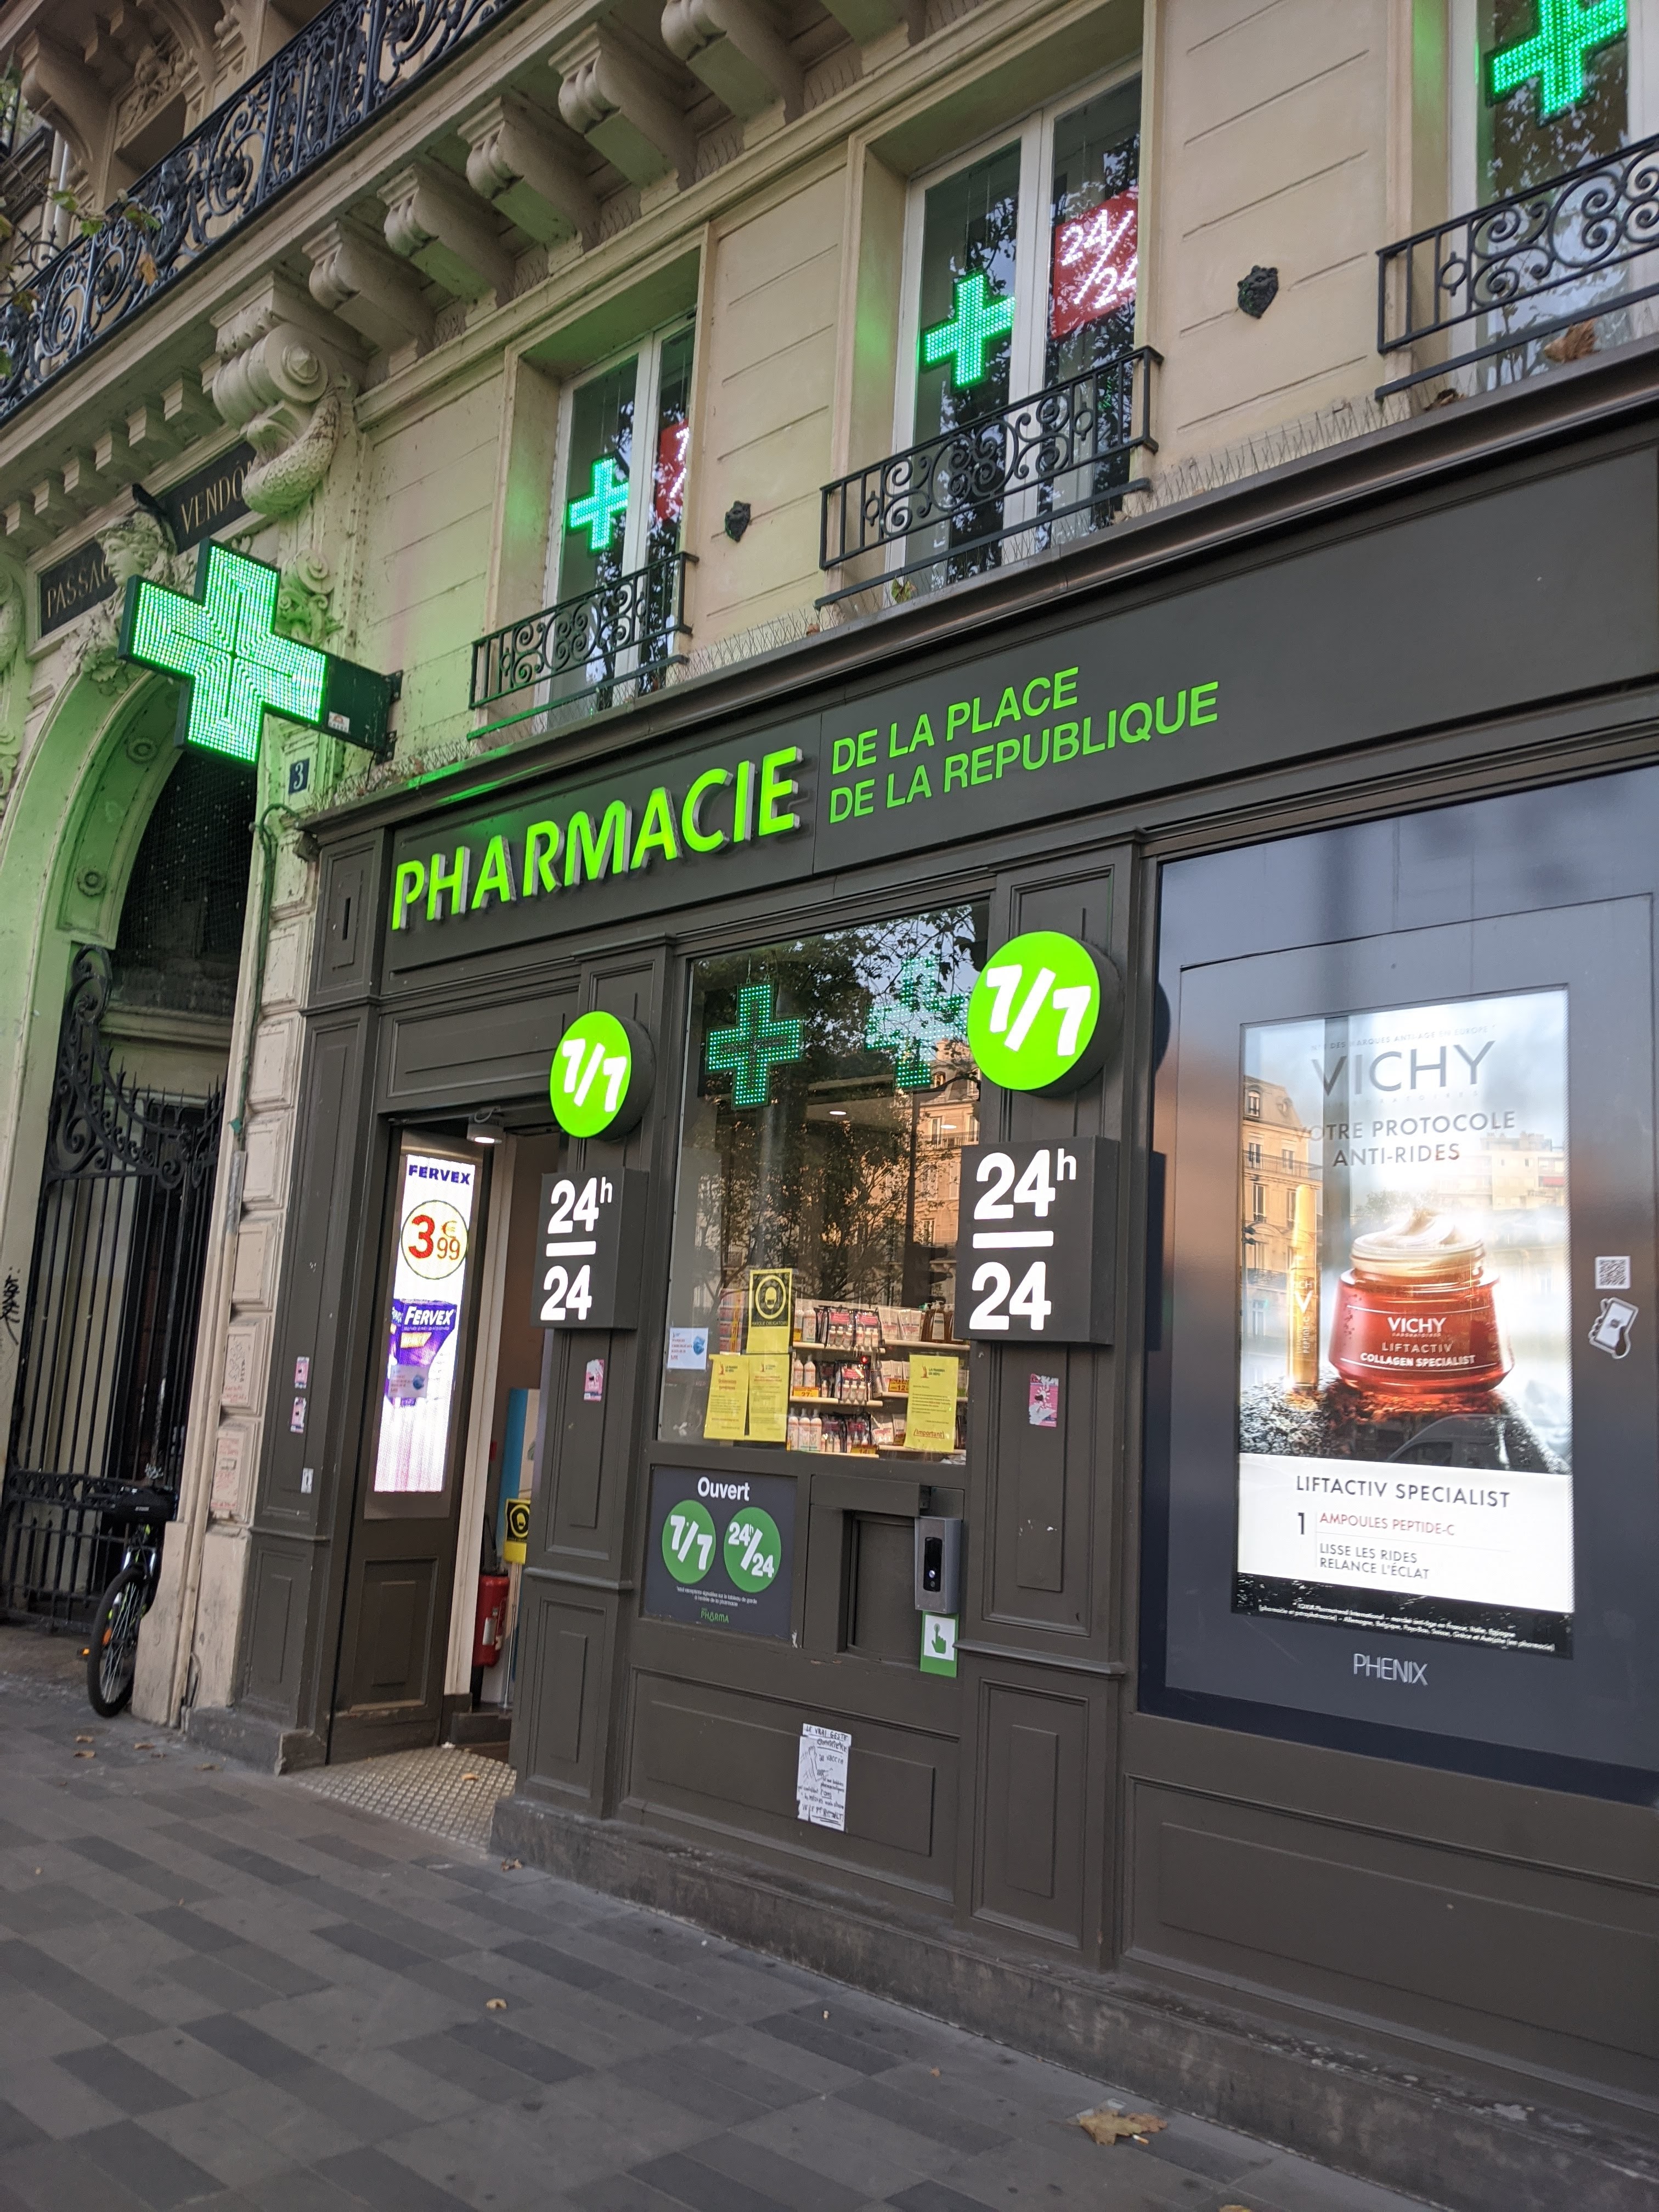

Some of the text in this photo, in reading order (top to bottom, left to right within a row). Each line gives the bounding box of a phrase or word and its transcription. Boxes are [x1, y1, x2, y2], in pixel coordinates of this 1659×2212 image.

[832, 667, 1079, 775] DE LA PLACE
[830, 681, 1218, 825] DE LA REPUBLIQUE
[293, 762, 303, 790] 3
[391, 746, 804, 932] PHARMACIE
[986, 964, 1091, 1056] 7/7
[562, 1038, 627, 1112] 7/7
[1311, 1040, 1496, 1097] VICHY
[1372, 1111, 1515, 1137] PROTOCOLE
[1333, 1143, 1460, 1167] ANTI-RIDES
[409, 1165, 471, 1185] FERVEX
[540, 1265, 592, 1321] 24
[969, 1261, 1052, 1330] 24
[404, 1306, 454, 1326] FERVEX
[1387, 1317, 1447, 1333] VICHY
[1360, 1352, 1476, 1367] COLLAGEN SPECIALIST
[1381, 1341, 1454, 1353] LIFTACTIV
[697, 1476, 750, 1502] Ouvert
[1296, 1475, 1510, 1508] LIFTACTIV SPECIALIST
[1297, 1512, 1305, 1535] 1
[1319, 1513, 1455, 1536] AMPOULES PEPTIDE-C
[1320, 1543, 1418, 1564] LISSE LES RIDES
[1320, 1557, 1429, 1579] RELANCE L'ÉCLAT
[1353, 1653, 1429, 1686] PHENIX
[815, 1727, 827, 1737] VRAI
[830, 1730, 848, 1741] GESTE
